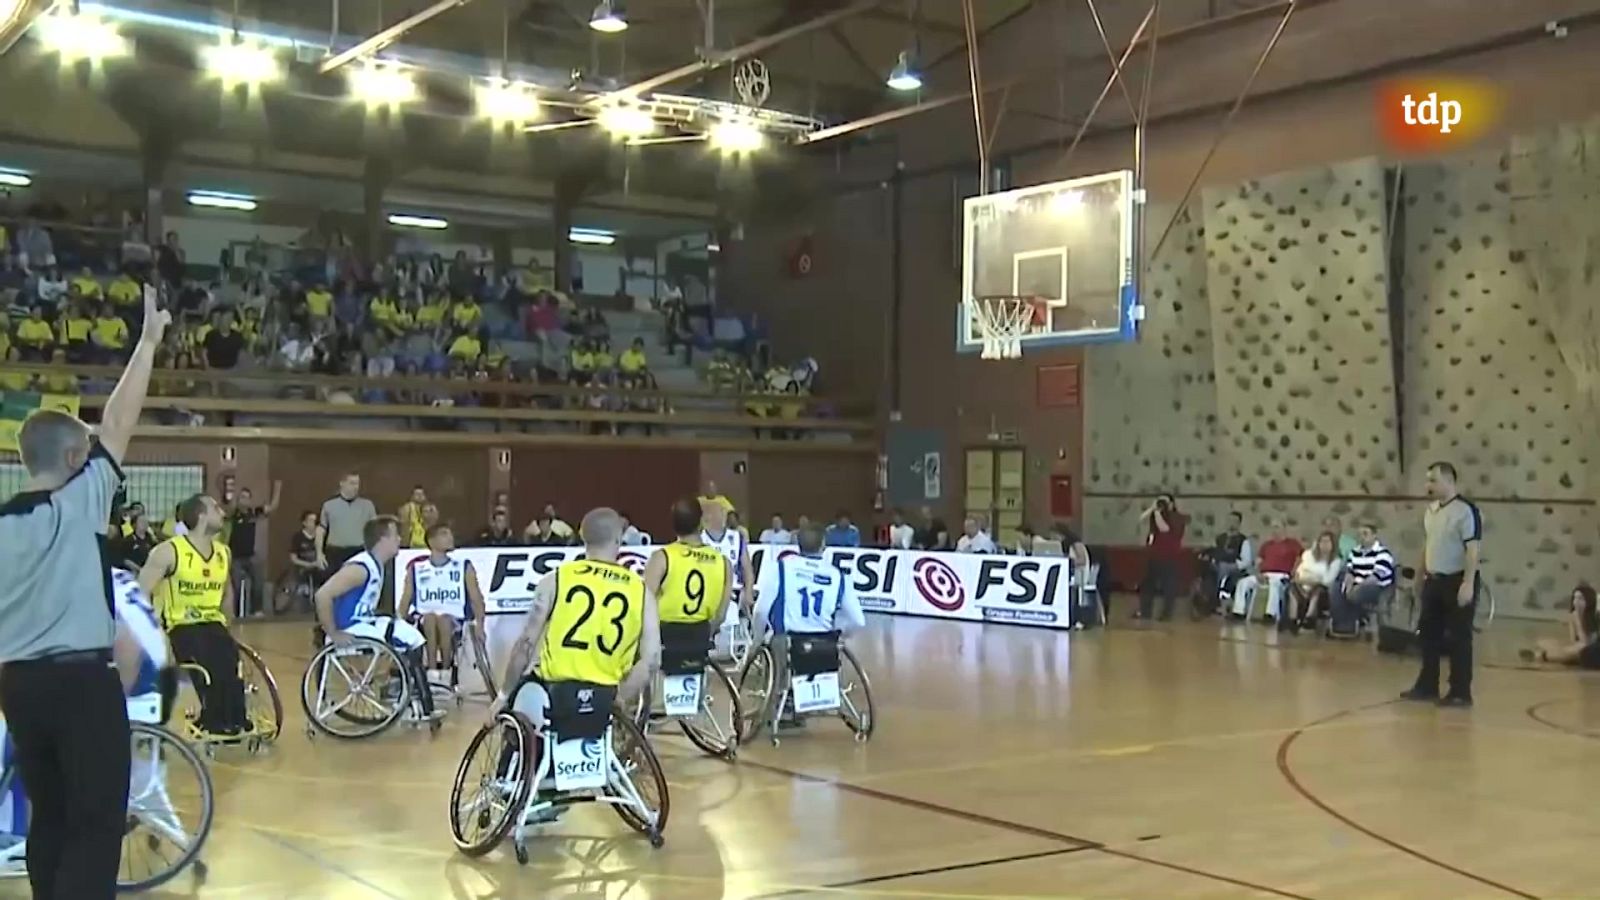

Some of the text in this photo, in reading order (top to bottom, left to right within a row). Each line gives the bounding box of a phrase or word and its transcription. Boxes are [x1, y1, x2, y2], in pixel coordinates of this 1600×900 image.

[185, 552, 194, 569] 7
[449, 570, 461, 583] 10
[489, 552, 587, 592] FS
[831, 552, 898, 593] FSI
[419, 586, 461, 605] Unipol
[683, 568, 705, 616] 9
[975, 560, 1062, 605] FSI
[797, 586, 824, 618] 11
[562, 585, 629, 656] 23
[557, 758, 602, 776] Sertel
